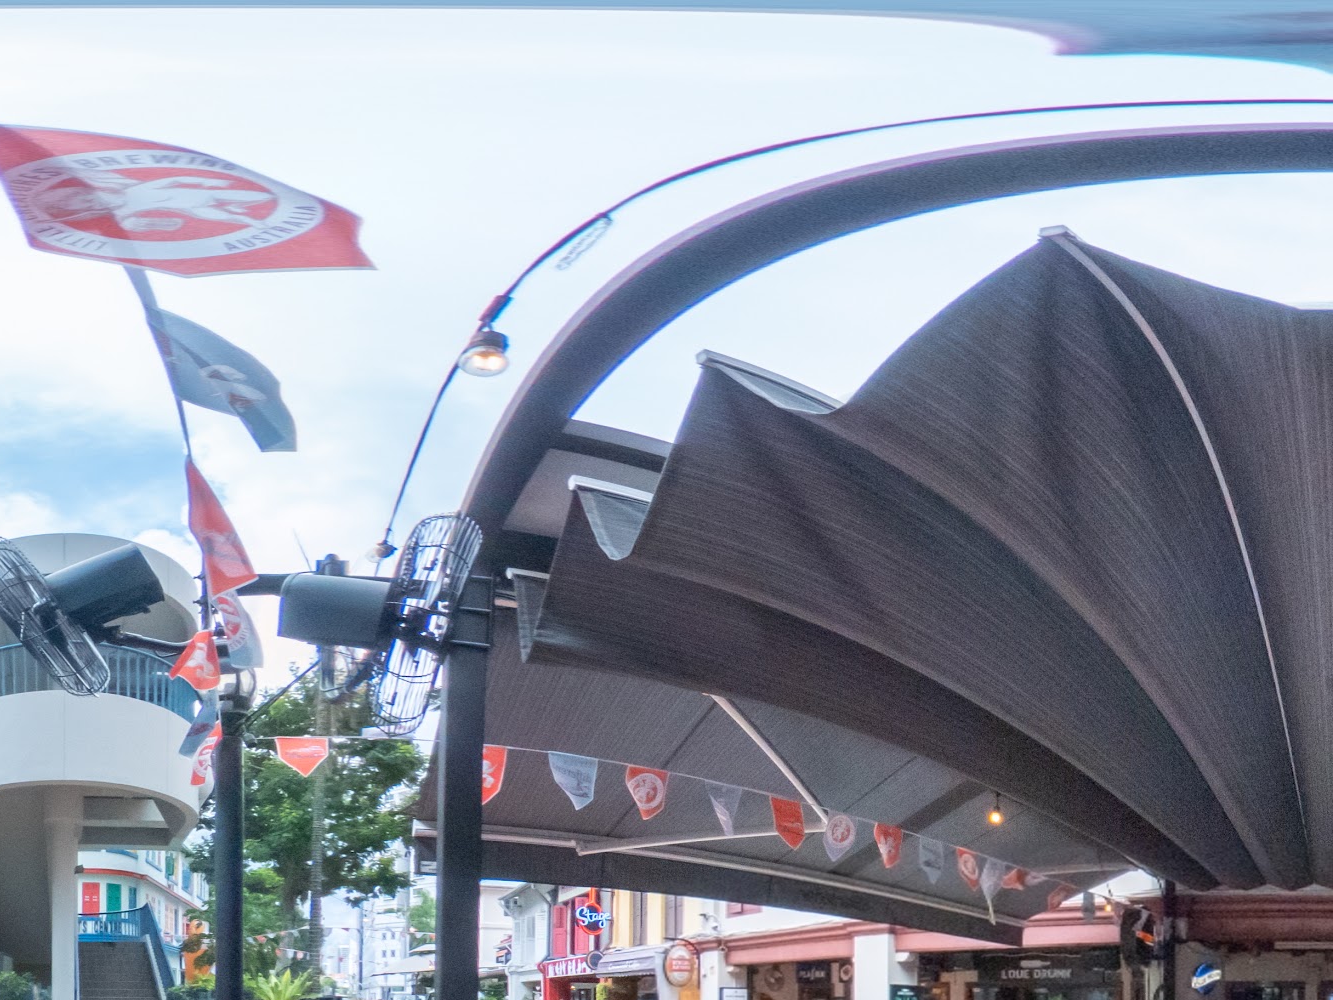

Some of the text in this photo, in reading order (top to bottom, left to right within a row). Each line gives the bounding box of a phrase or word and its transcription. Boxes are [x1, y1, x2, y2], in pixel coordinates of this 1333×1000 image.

[72, 153, 236, 171] BREWING
[223, 206, 317, 251] AUSTRALIA
[576, 906, 611, 928] Stage
